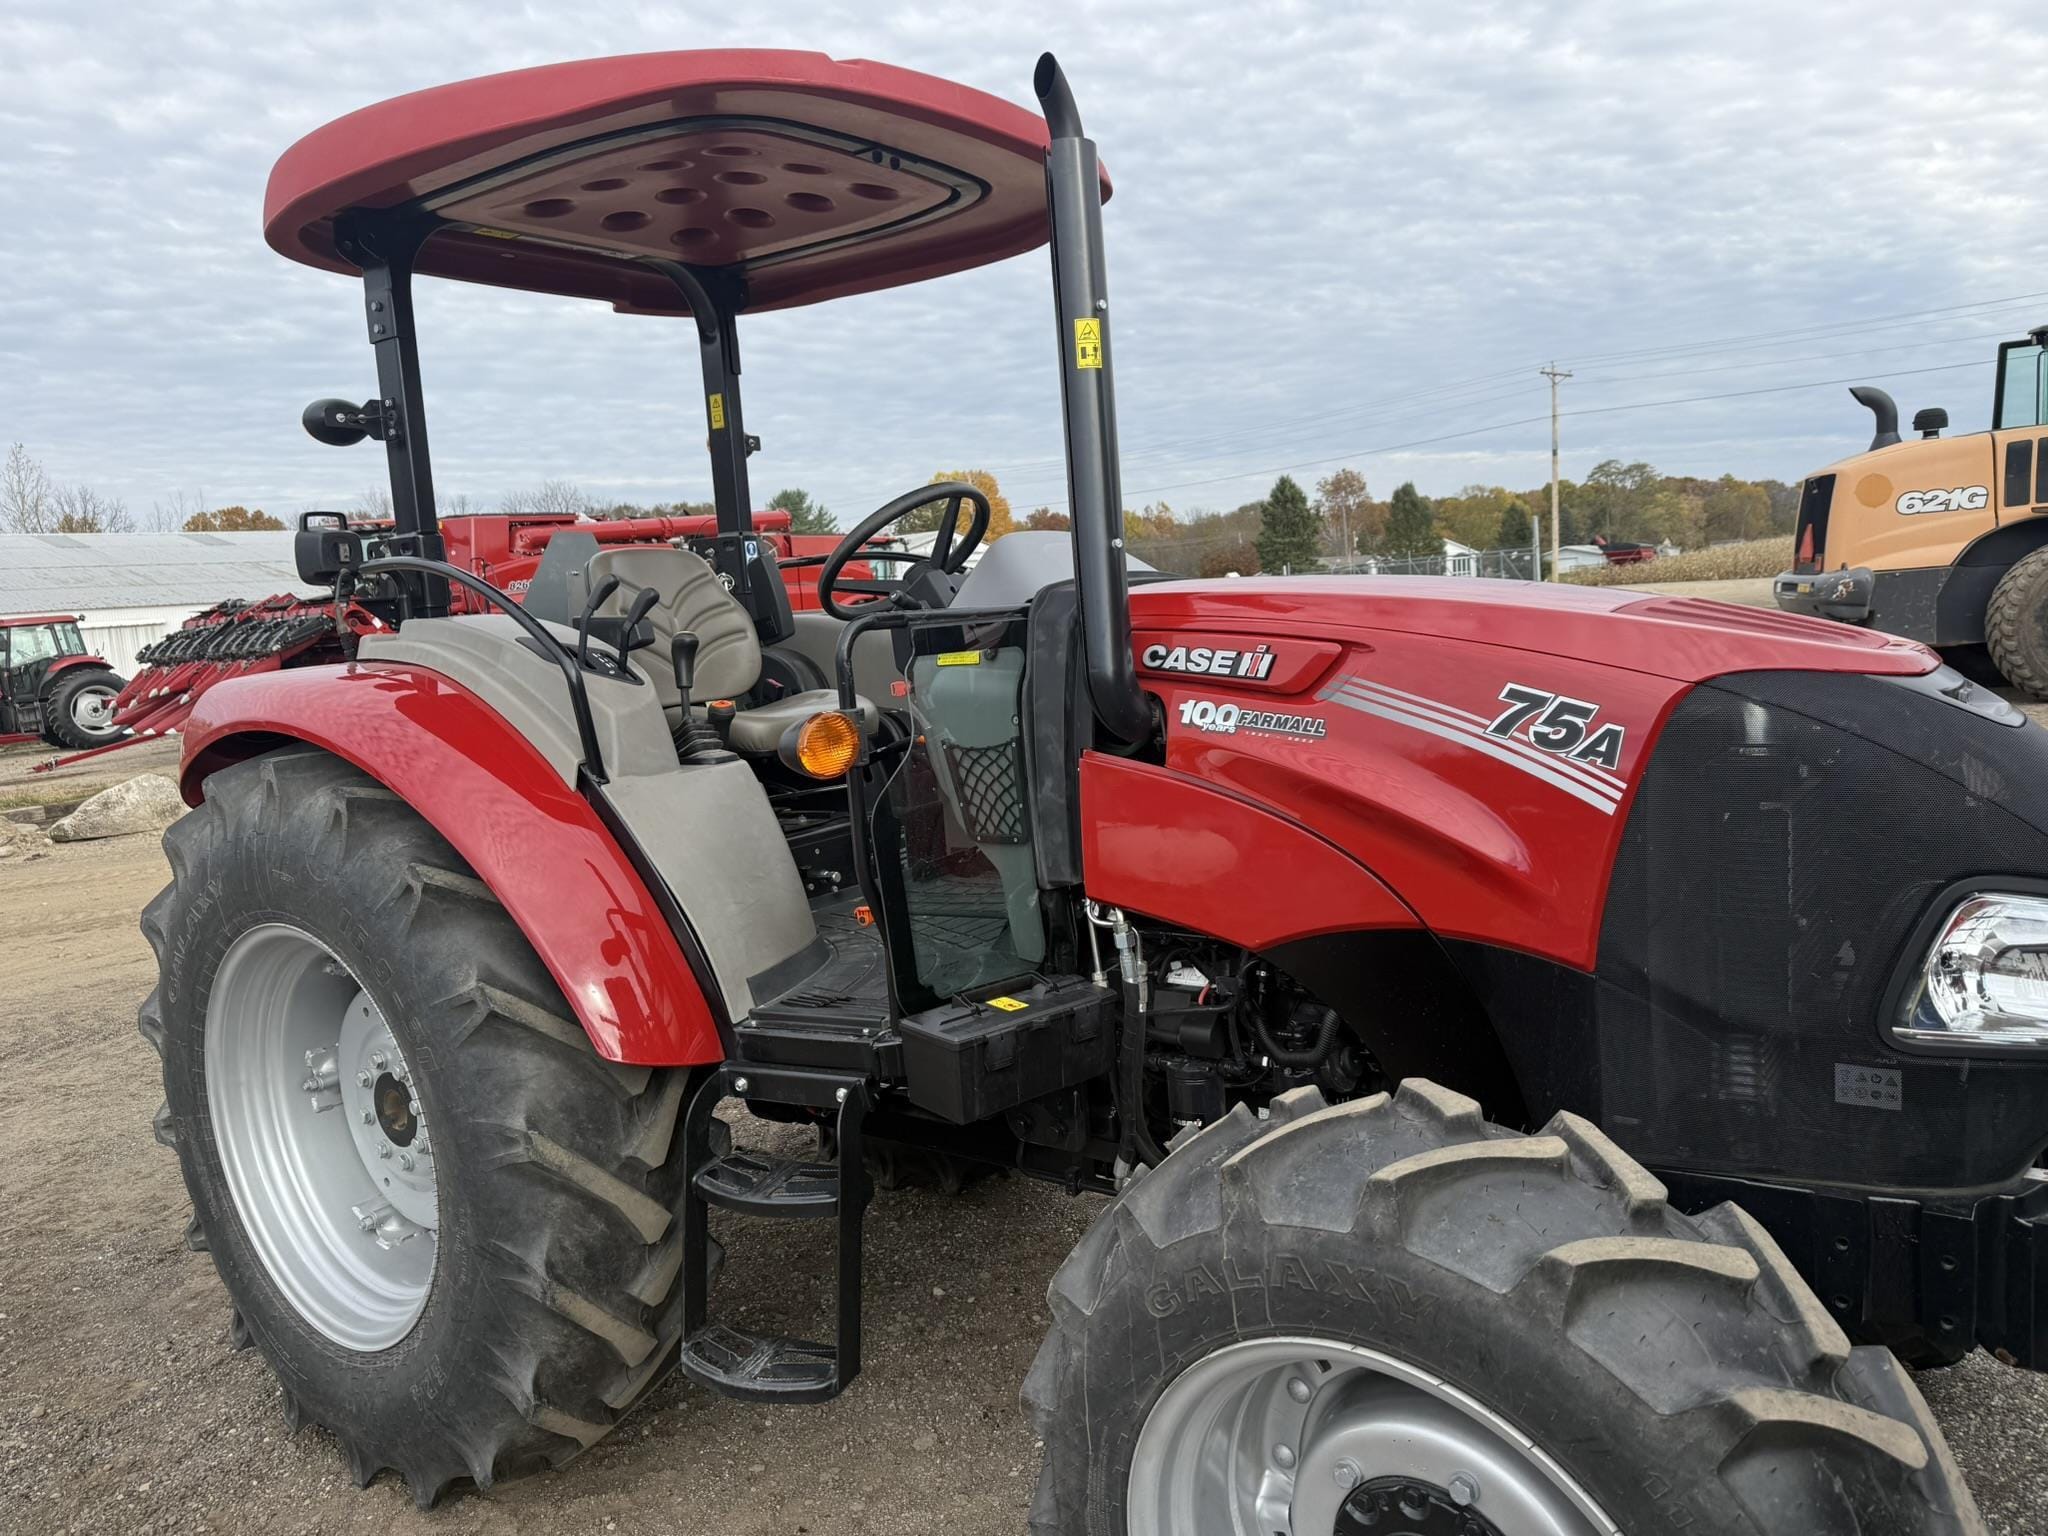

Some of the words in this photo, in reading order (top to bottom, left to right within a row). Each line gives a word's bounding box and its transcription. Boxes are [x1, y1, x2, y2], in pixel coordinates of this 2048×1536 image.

[1896, 485, 1988, 515] 621G
[1142, 644, 1238, 675] CASE
[1178, 699, 1241, 726] 100
[1237, 709, 1327, 737] FARMALL
[1201, 721, 1237, 734] years
[1484, 682, 1625, 771] 75A
[168, 872, 223, 1004] GALAXY
[1144, 1253, 1440, 1320] GALAXY
